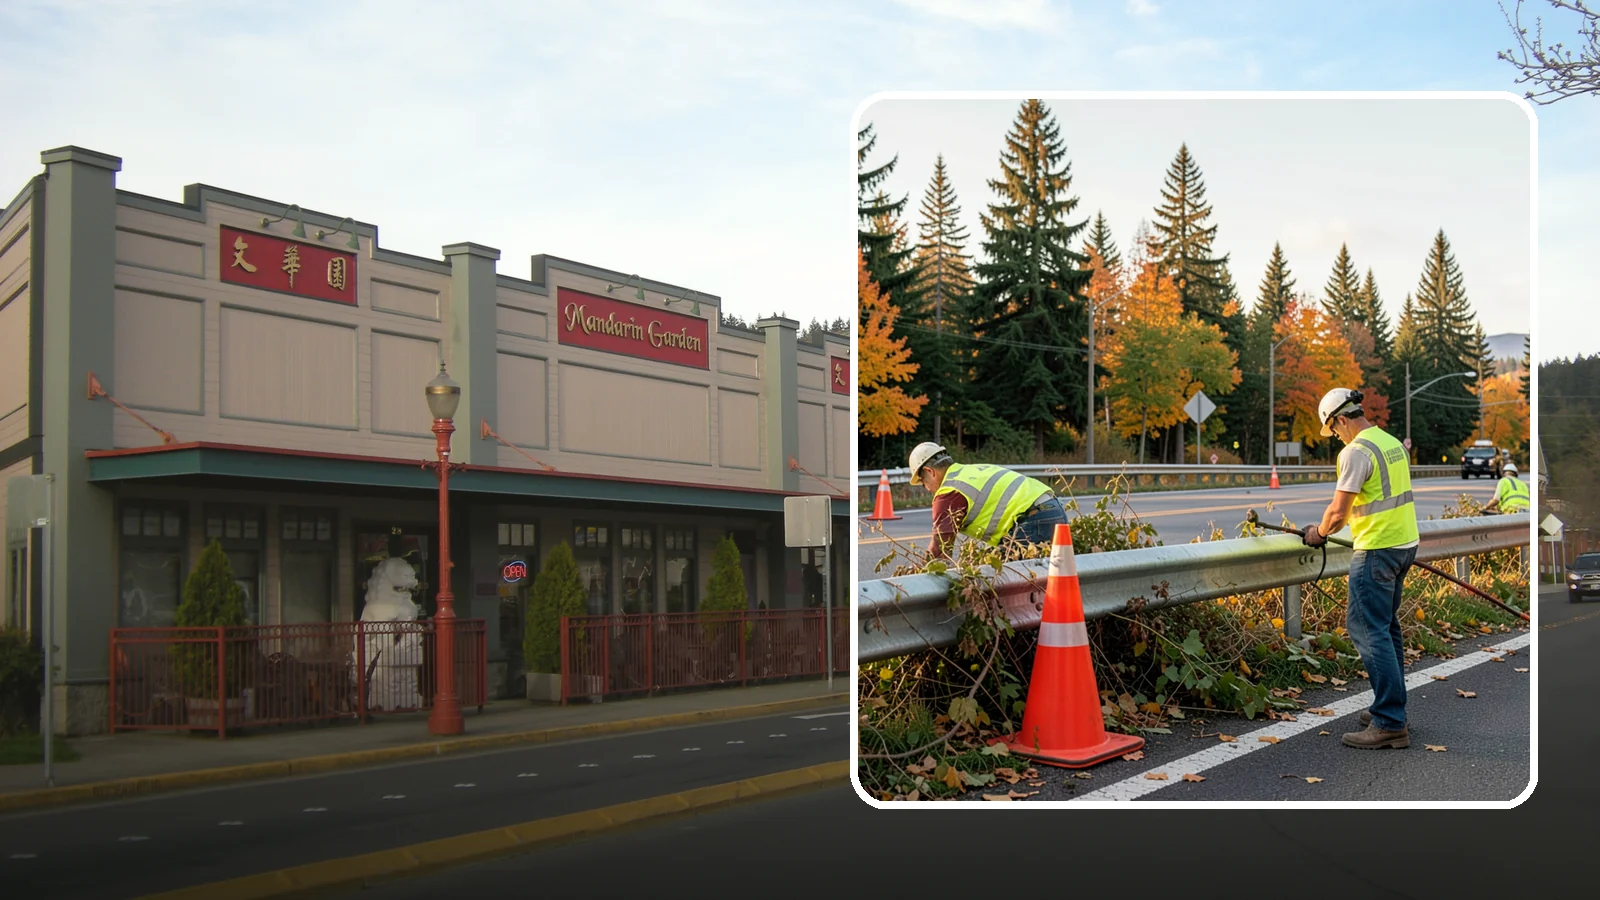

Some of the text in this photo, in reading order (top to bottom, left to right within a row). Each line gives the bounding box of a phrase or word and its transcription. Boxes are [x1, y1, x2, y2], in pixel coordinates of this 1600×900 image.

[231, 235, 346, 291] 文華園
[564, 302, 702, 352] Mandarin Garden
[835, 363, 846, 386] 文
[503, 565, 527, 578] OPEN
